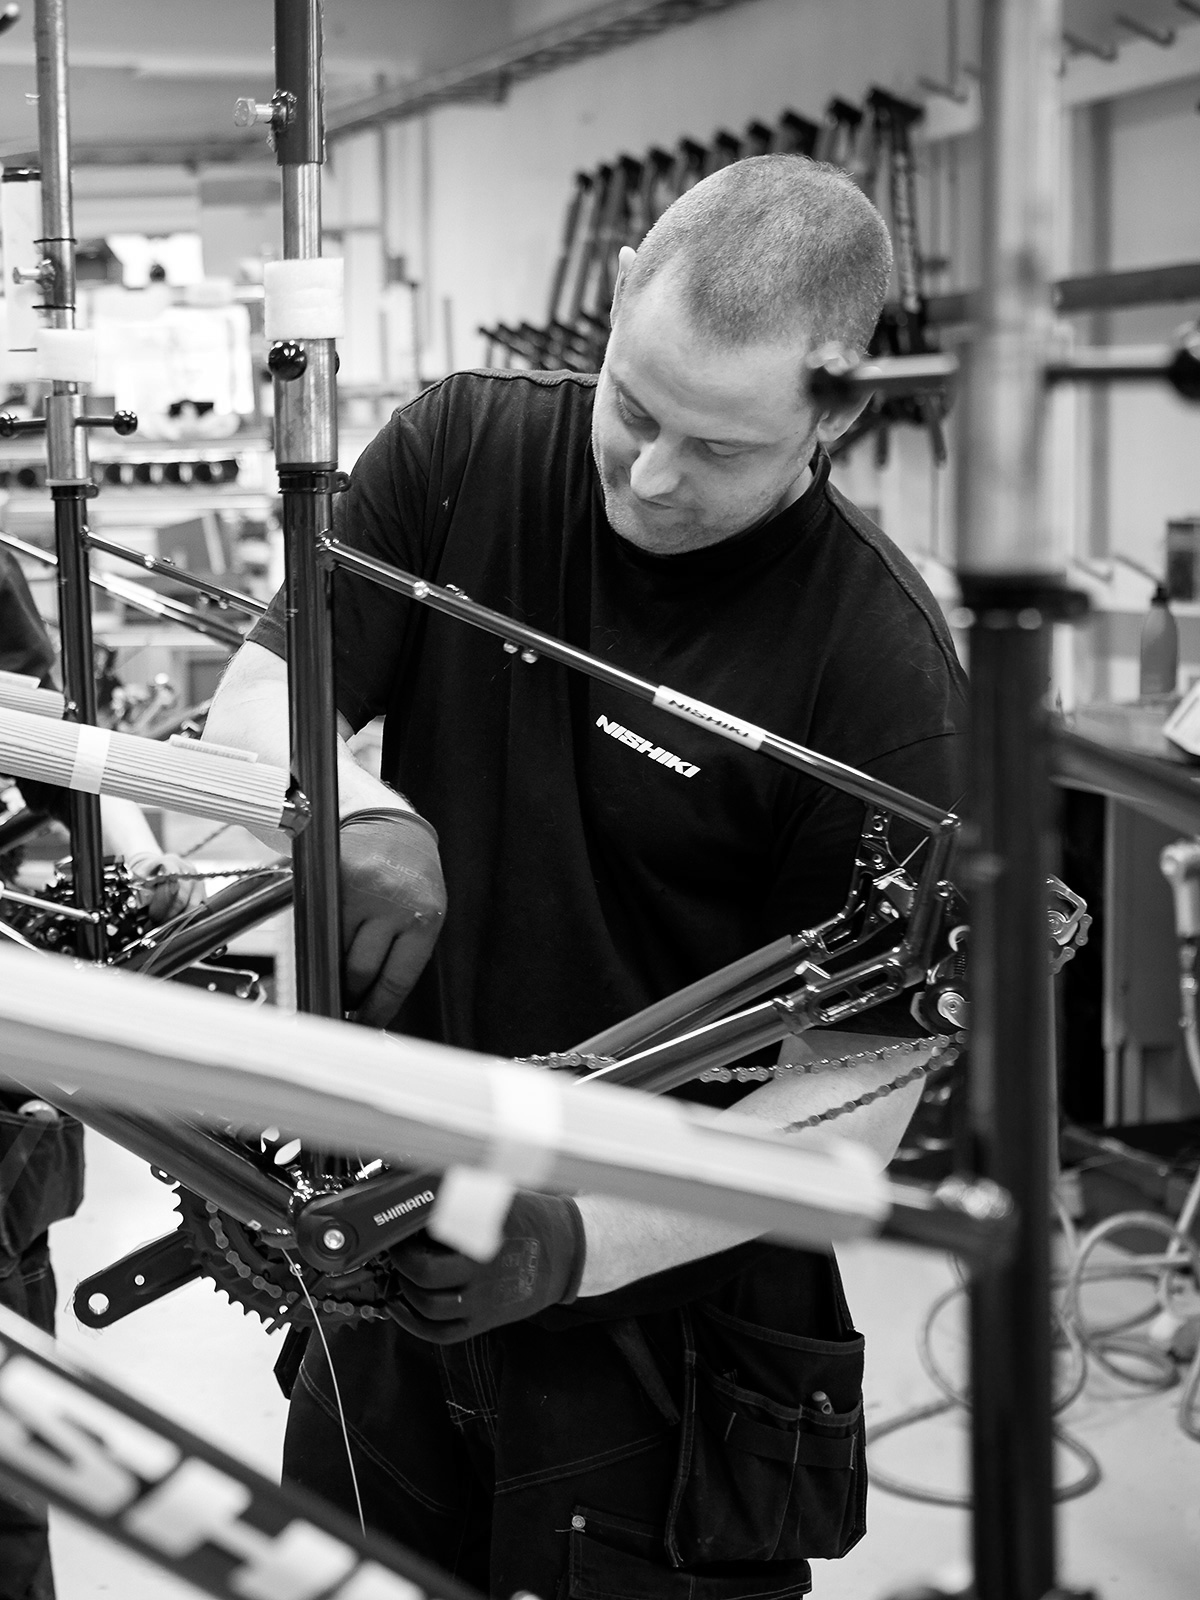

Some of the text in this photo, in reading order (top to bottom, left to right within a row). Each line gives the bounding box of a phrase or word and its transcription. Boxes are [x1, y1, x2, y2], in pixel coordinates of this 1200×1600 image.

[668, 700, 749, 738] NISHIKI
[595, 714, 701, 778] NISHIKI
[373, 1189, 435, 1226] SHIMANO
